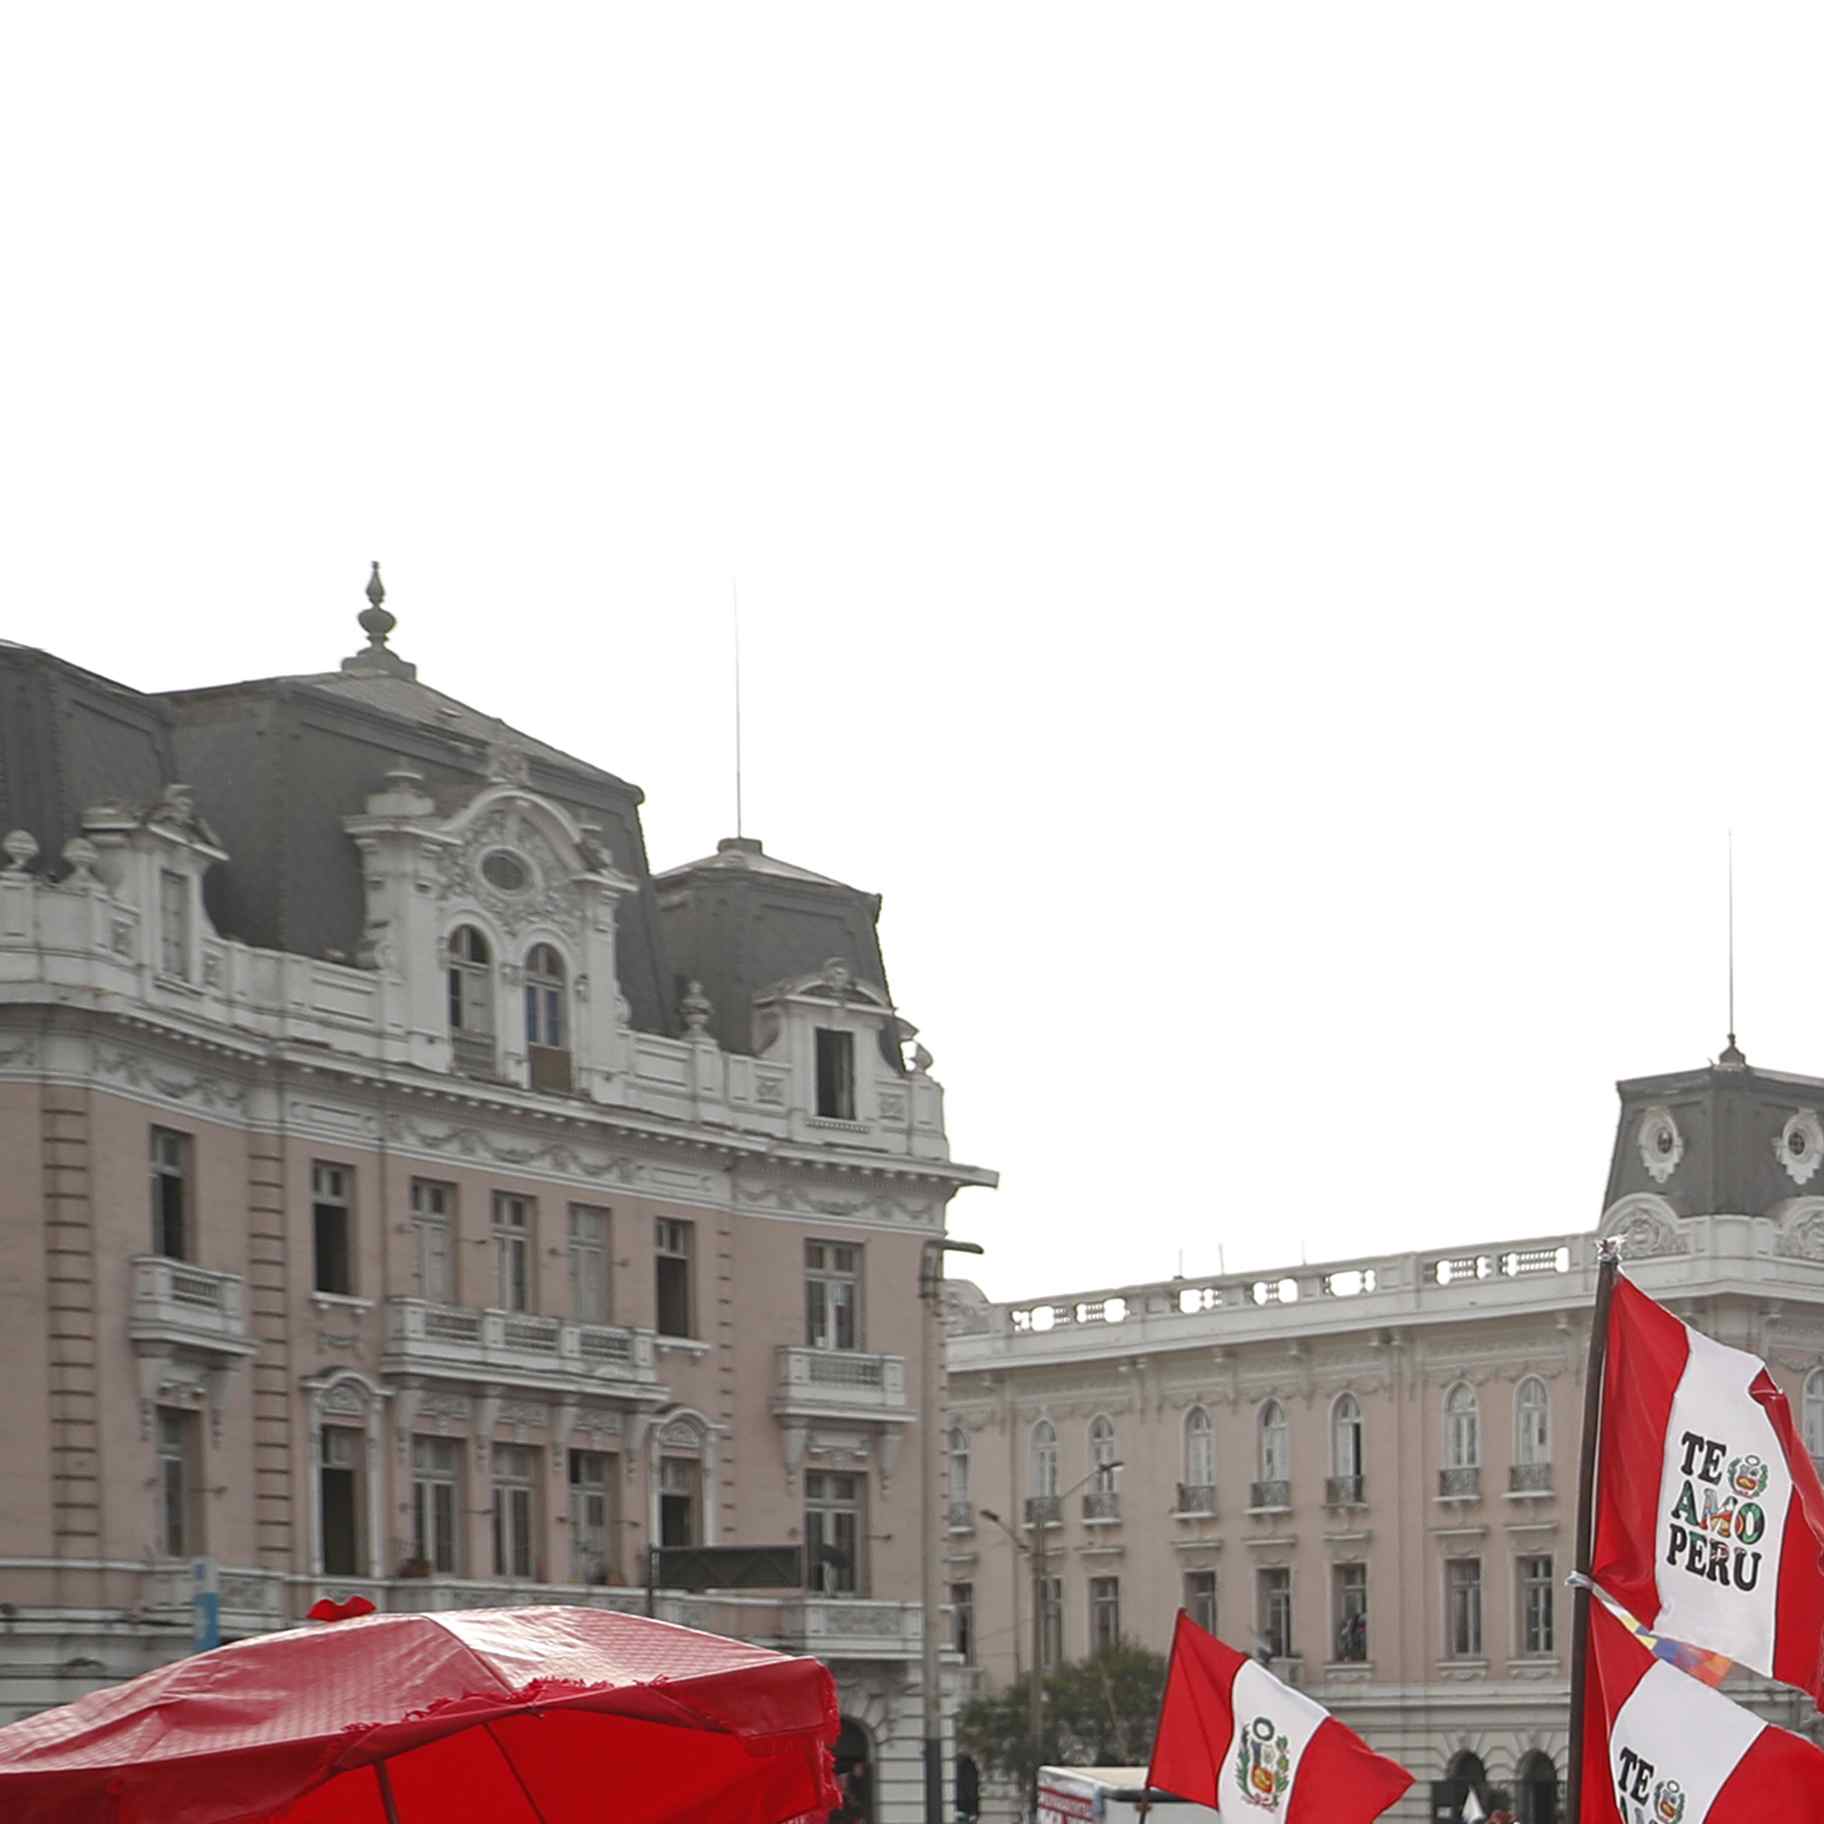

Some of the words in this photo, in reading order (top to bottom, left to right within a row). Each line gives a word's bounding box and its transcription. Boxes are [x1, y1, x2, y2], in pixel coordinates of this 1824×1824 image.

[1681, 1431, 1726, 1486] TE
[1671, 1479, 1765, 1545] AMO
[1666, 1523, 1763, 1592] PERU
[1619, 1746, 1654, 1806] TE
